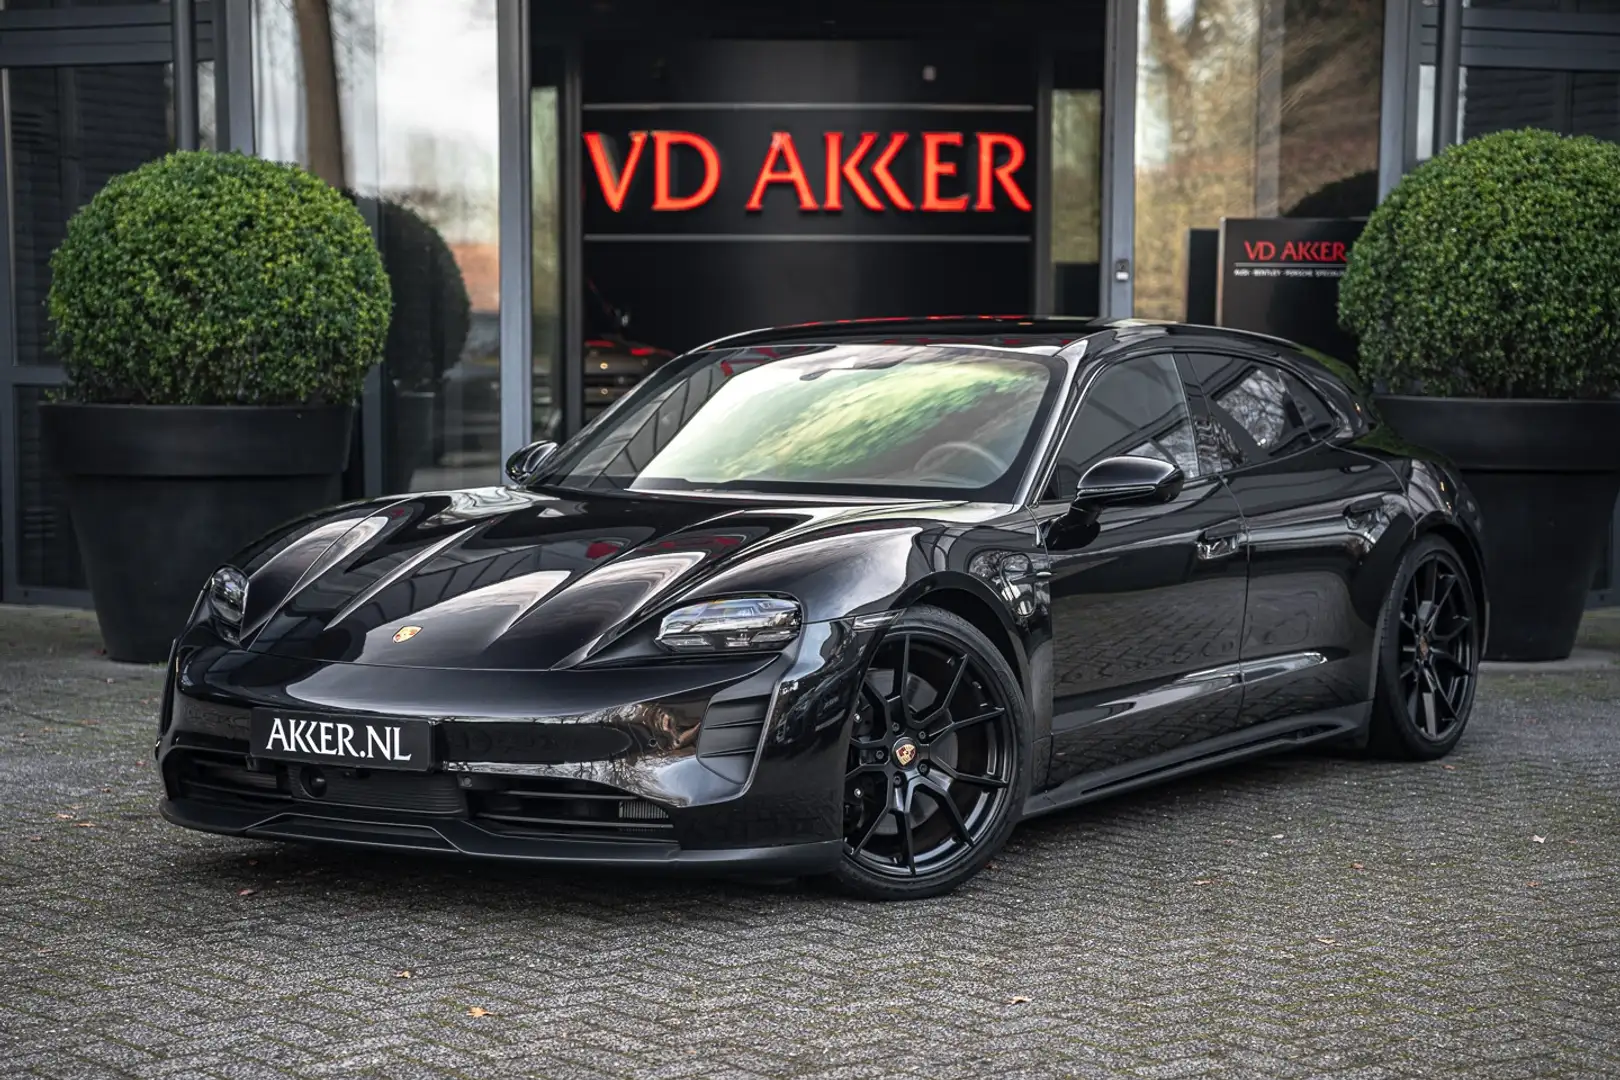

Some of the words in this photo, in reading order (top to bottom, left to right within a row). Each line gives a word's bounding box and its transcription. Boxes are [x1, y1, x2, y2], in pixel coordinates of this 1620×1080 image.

[583, 131, 722, 213] VD
[745, 131, 1033, 213] AKKER
[1244, 240, 1276, 261] VD
[1280, 241, 1347, 262] AKKER
[265, 717, 412, 761] AKKER.NL
